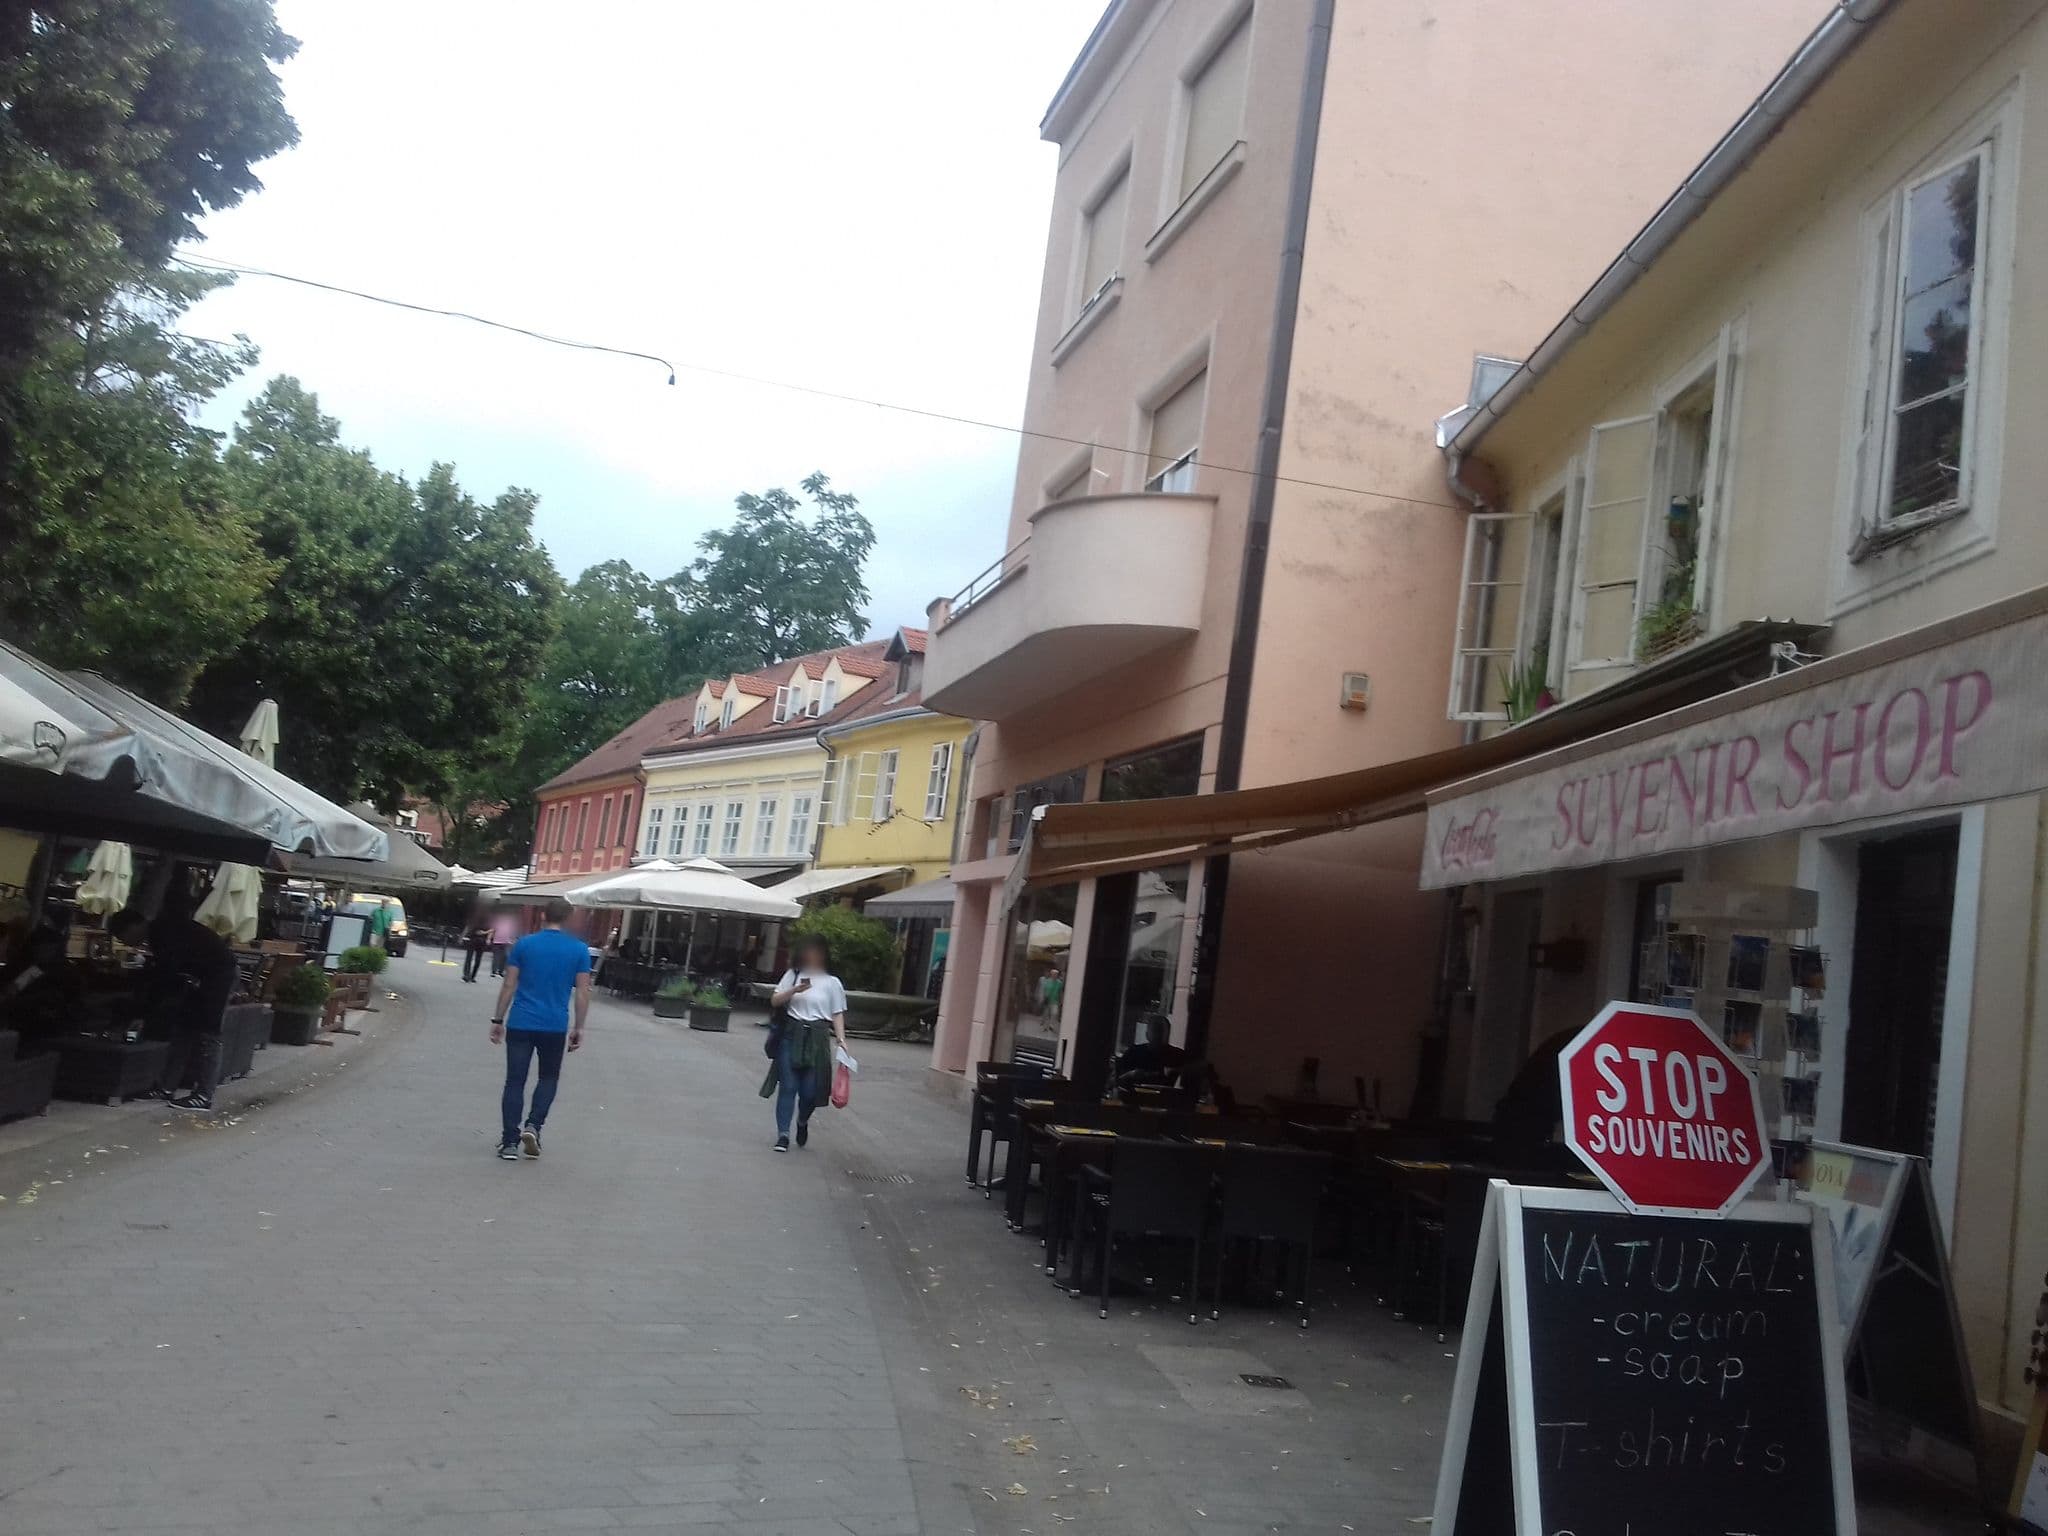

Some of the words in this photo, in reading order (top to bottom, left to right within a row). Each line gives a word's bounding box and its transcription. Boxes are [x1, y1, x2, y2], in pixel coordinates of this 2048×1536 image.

[1552, 735, 1761, 850] SUVENIR
[1774, 668, 1994, 810] SHOP
[1594, 1043, 1727, 1121] STOP
[1587, 1113, 1752, 1166] SOUVENIRS
